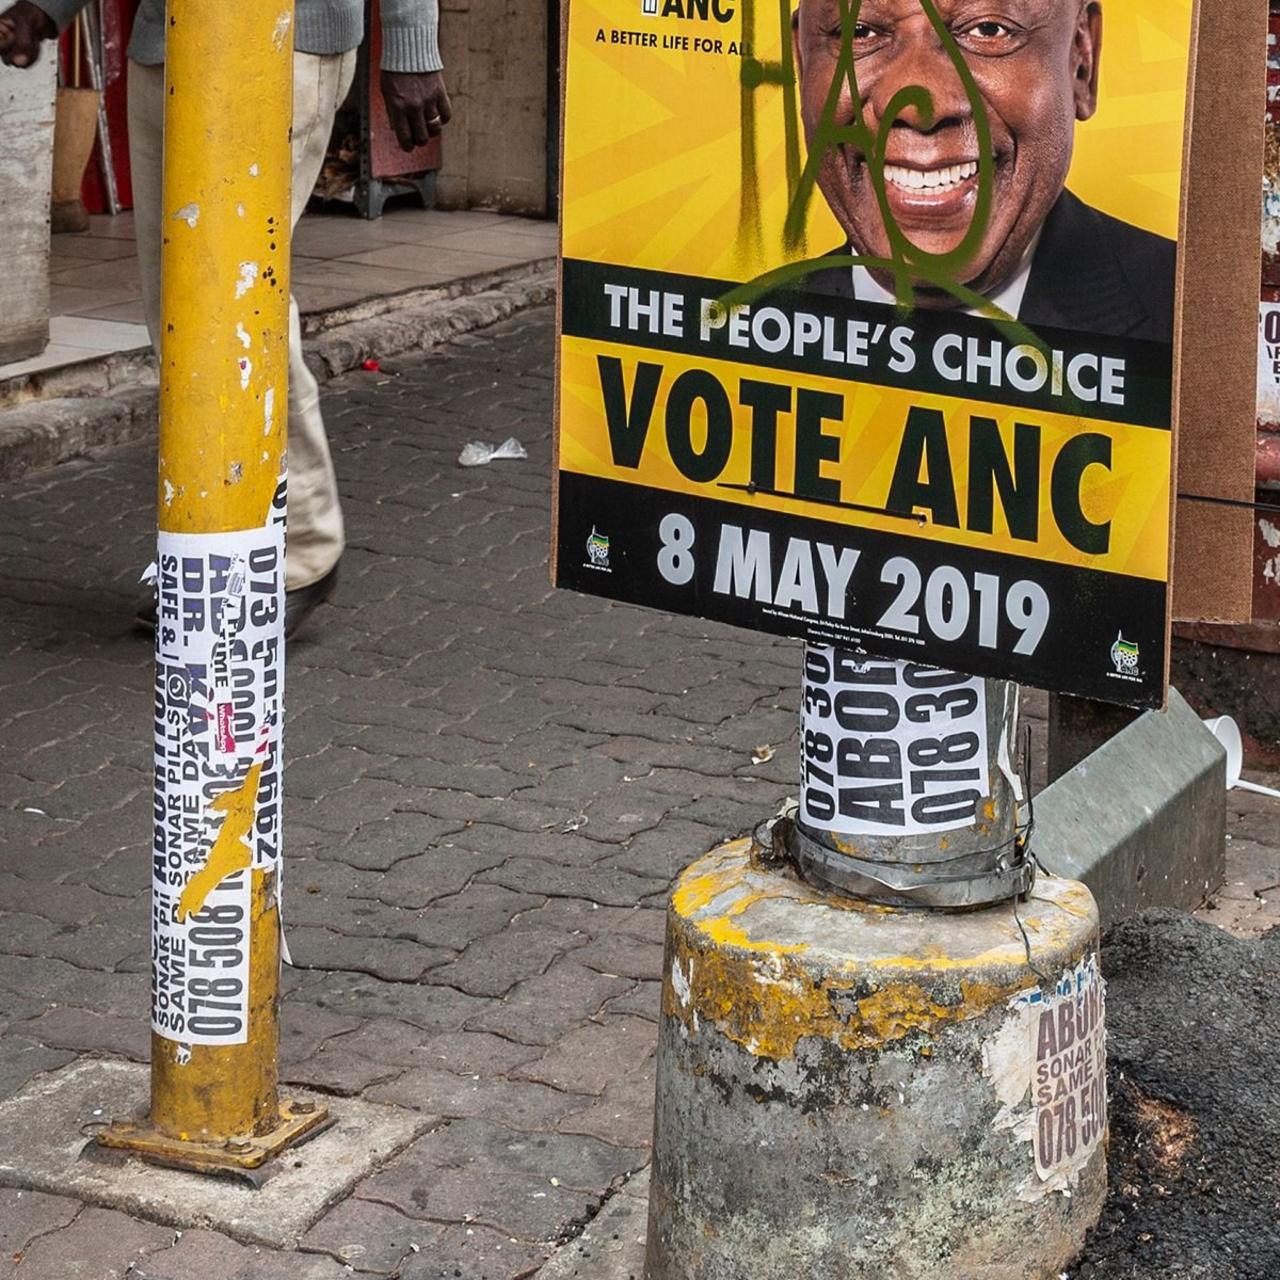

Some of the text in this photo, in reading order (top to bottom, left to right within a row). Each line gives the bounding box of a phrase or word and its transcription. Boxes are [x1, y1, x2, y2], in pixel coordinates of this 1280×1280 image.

[596, 28, 755, 57] A BETTER LIFE FOR ALL
[603, 282, 684, 338] THE
[931, 333, 1127, 407] CHOICE
[596, 354, 1114, 555] VOTE ANC
[161, 554, 179, 648] SAFE &
[249, 545, 279, 627] 073
[657, 512, 1051, 657] 8 MAY 2019
[805, 651, 836, 822] 078 30
[906, 731, 982, 825] 078
[167, 709, 182, 887] SONAR PILLS
[158, 933, 170, 1026] SONAR
[170, 938, 186, 1034] SAME
[187, 977, 243, 1036] 078
[1037, 1060, 1094, 1107] SAME
[1038, 1038, 1092, 1085] SONAR
[1038, 1095, 1077, 1170] 078
